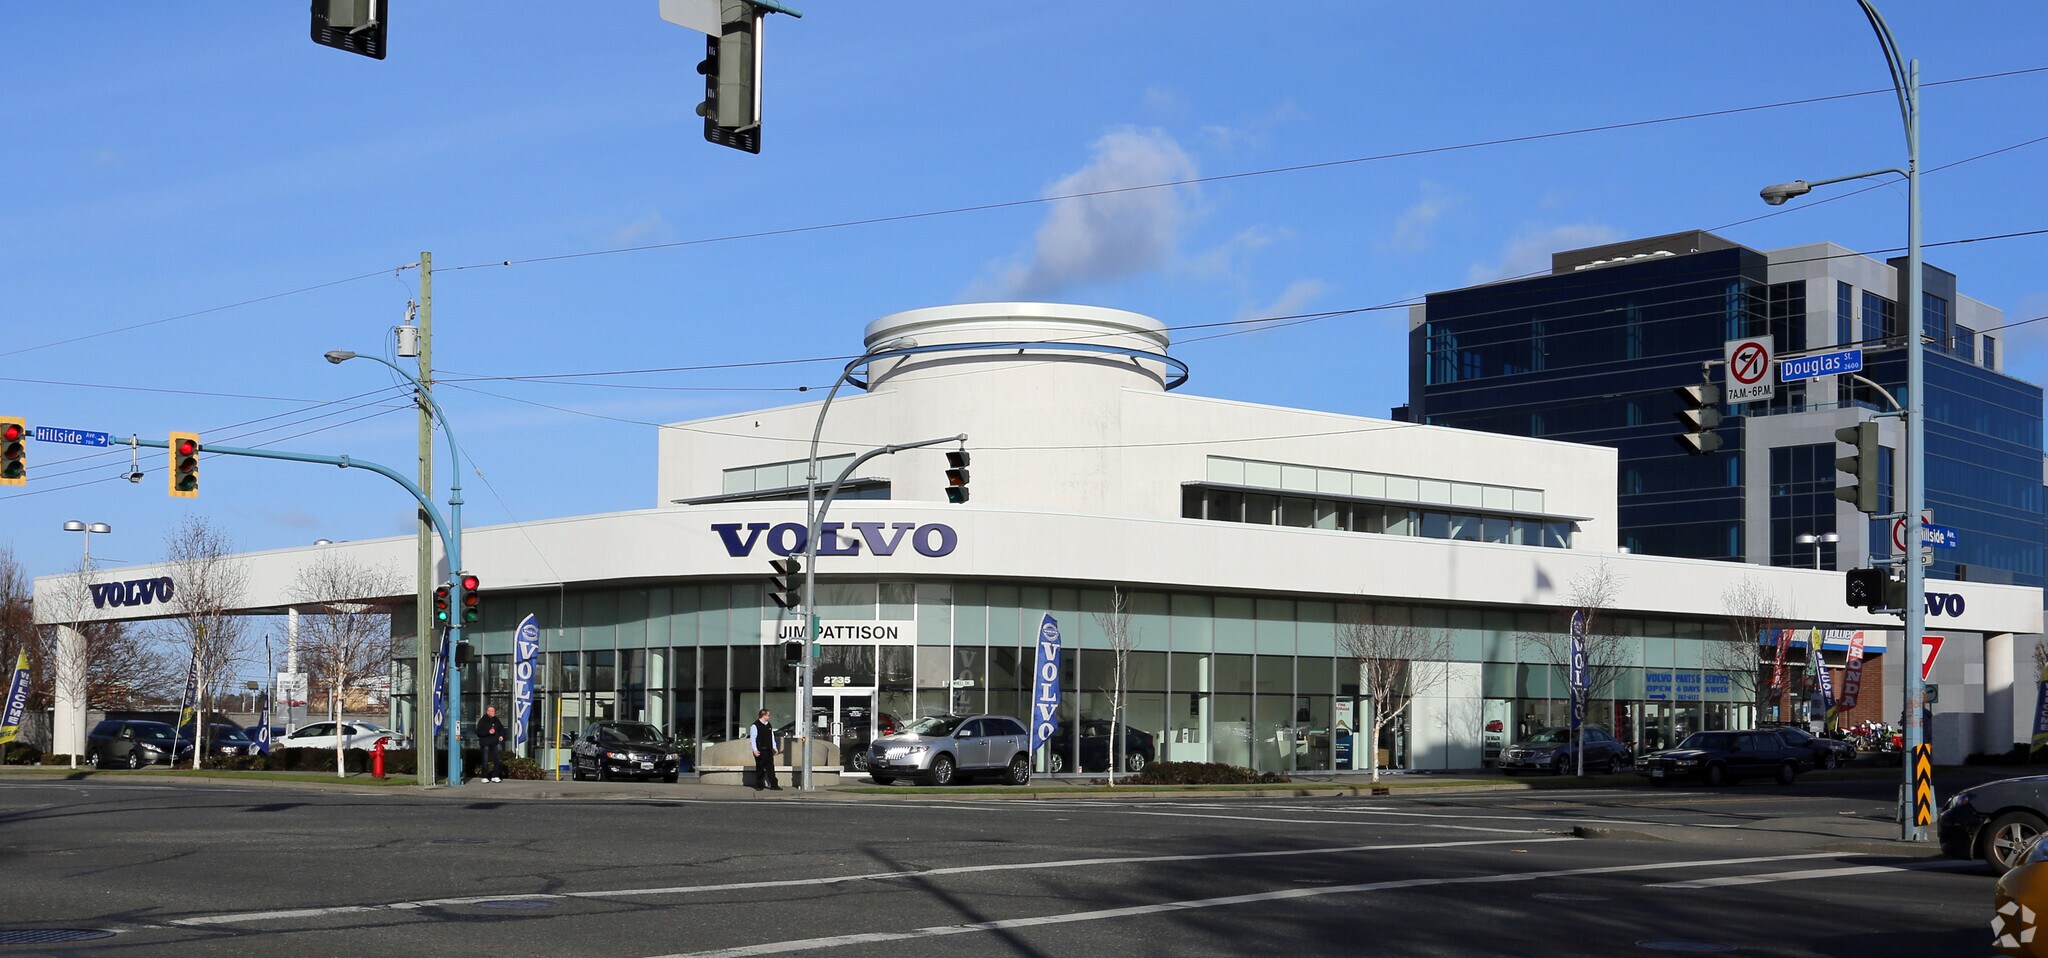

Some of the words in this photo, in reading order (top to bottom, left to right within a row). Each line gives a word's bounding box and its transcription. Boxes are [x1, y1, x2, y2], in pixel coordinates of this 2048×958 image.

[1785, 356, 1840, 376] Douglas
[1843, 353, 1853, 361] St.
[1844, 362, 1859, 370] 2600
[37, 428, 83, 444] Hillside
[711, 522, 958, 557] VOLVO
[1921, 527, 1945, 544] illside
[88, 576, 175, 609] VOLVO
[778, 626, 806, 639] JIM
[823, 676, 852, 684] 2735
[1646, 673, 1672, 683] VOLVO
[1675, 674, 1695, 684] PARTS
[1845, 646, 1863, 706] HONDA
[8, 671, 30, 725] WELCOME
[515, 641, 539, 737] VOLVO
[1036, 641, 1061, 741] VOLVO
